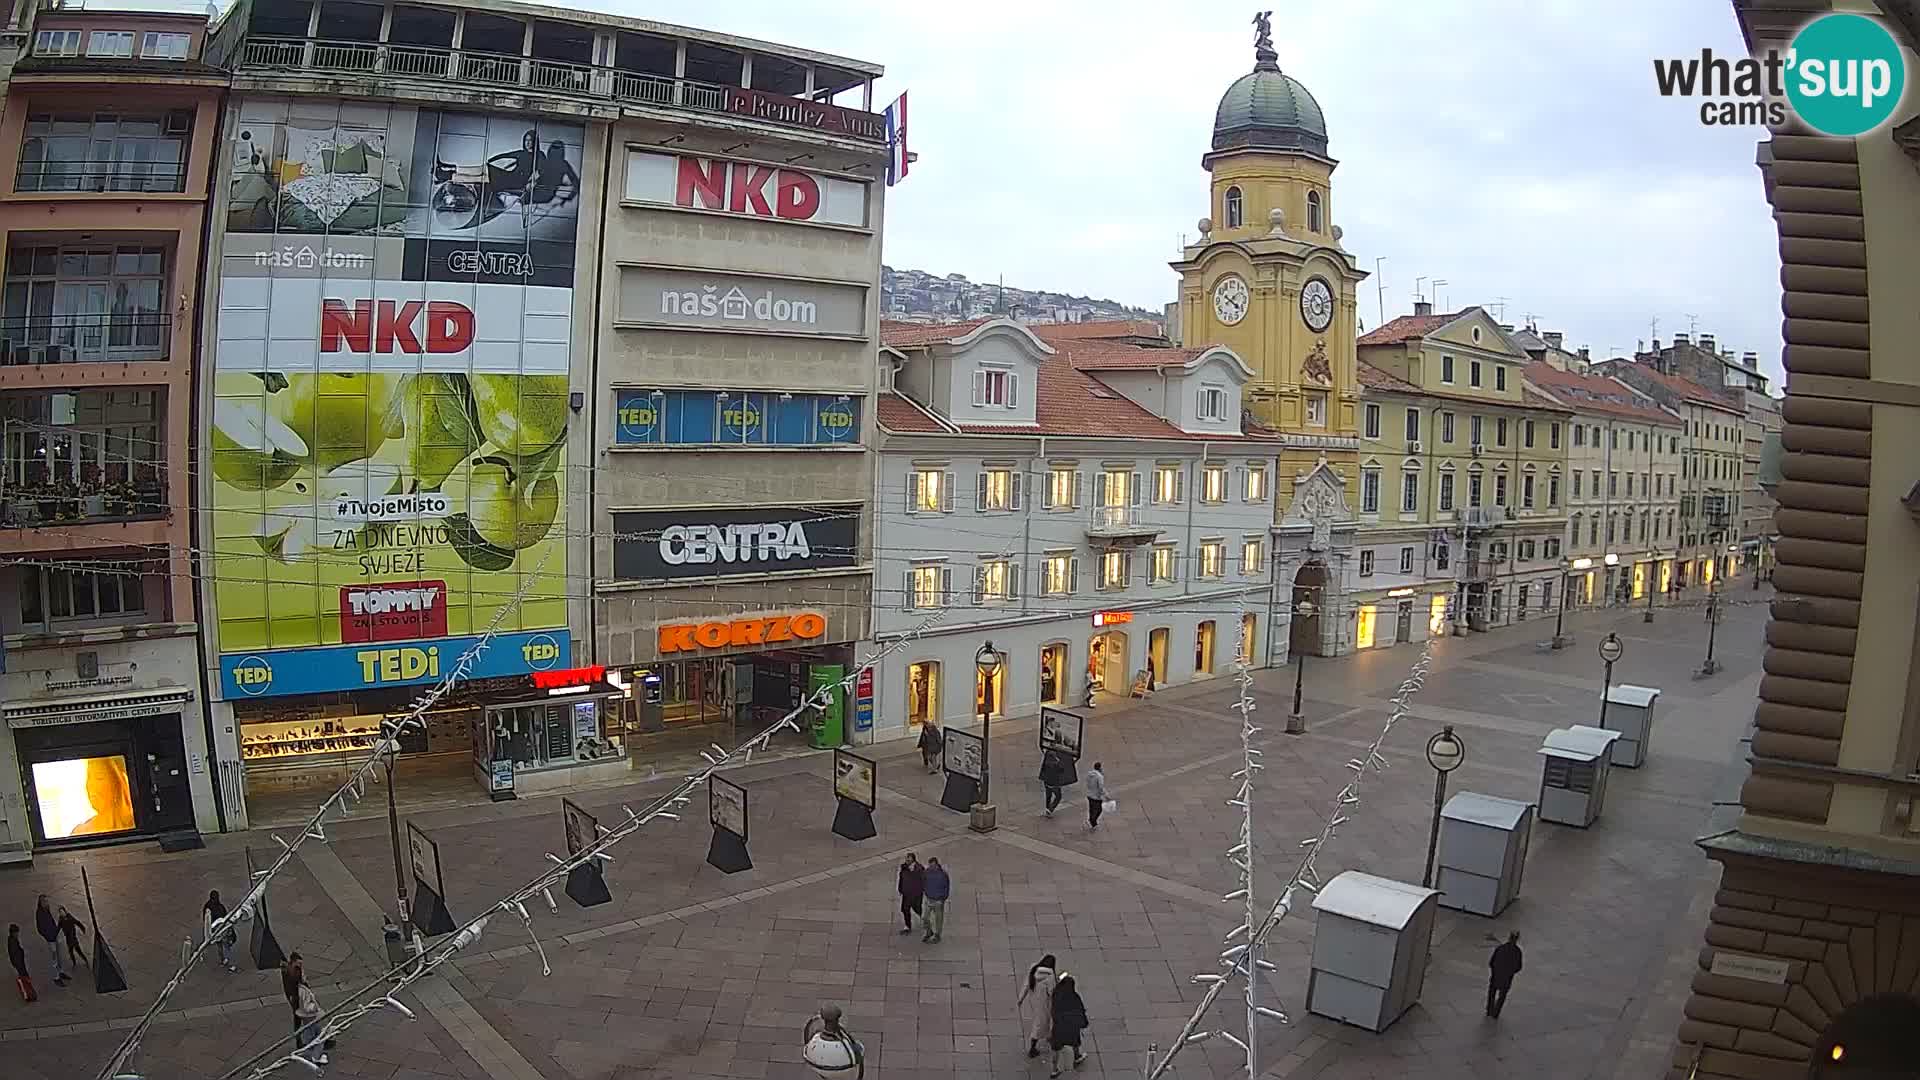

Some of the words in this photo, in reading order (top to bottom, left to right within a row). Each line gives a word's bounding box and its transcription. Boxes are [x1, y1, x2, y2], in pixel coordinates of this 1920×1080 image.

[724, 87, 745, 112] Le
[676, 158, 820, 220] NKD
[254, 244, 293, 268] naš
[319, 246, 365, 270] dom
[447, 250, 535, 277] CENTRA
[661, 285, 717, 316] naš
[754, 287, 817, 323] dom
[320, 297, 477, 354] NKD
[618, 407, 658, 426] TEDi
[723, 409, 760, 427] TEDi
[819, 410, 853, 428] TEDi
[337, 497, 446, 517] #TvojeMisto
[333, 528, 357, 550] ZA
[364, 523, 450, 549] DNEVNO
[658, 522, 811, 565] CENTRA
[358, 549, 426, 576] SVJEŽE
[348, 587, 439, 615] TOMMY
[402, 611, 430, 624] VOLŠ
[658, 614, 827, 653] KORZO
[357, 646, 441, 684] TEDi
[521, 642, 560, 662] TEDi
[232, 662, 273, 686] TEDi
